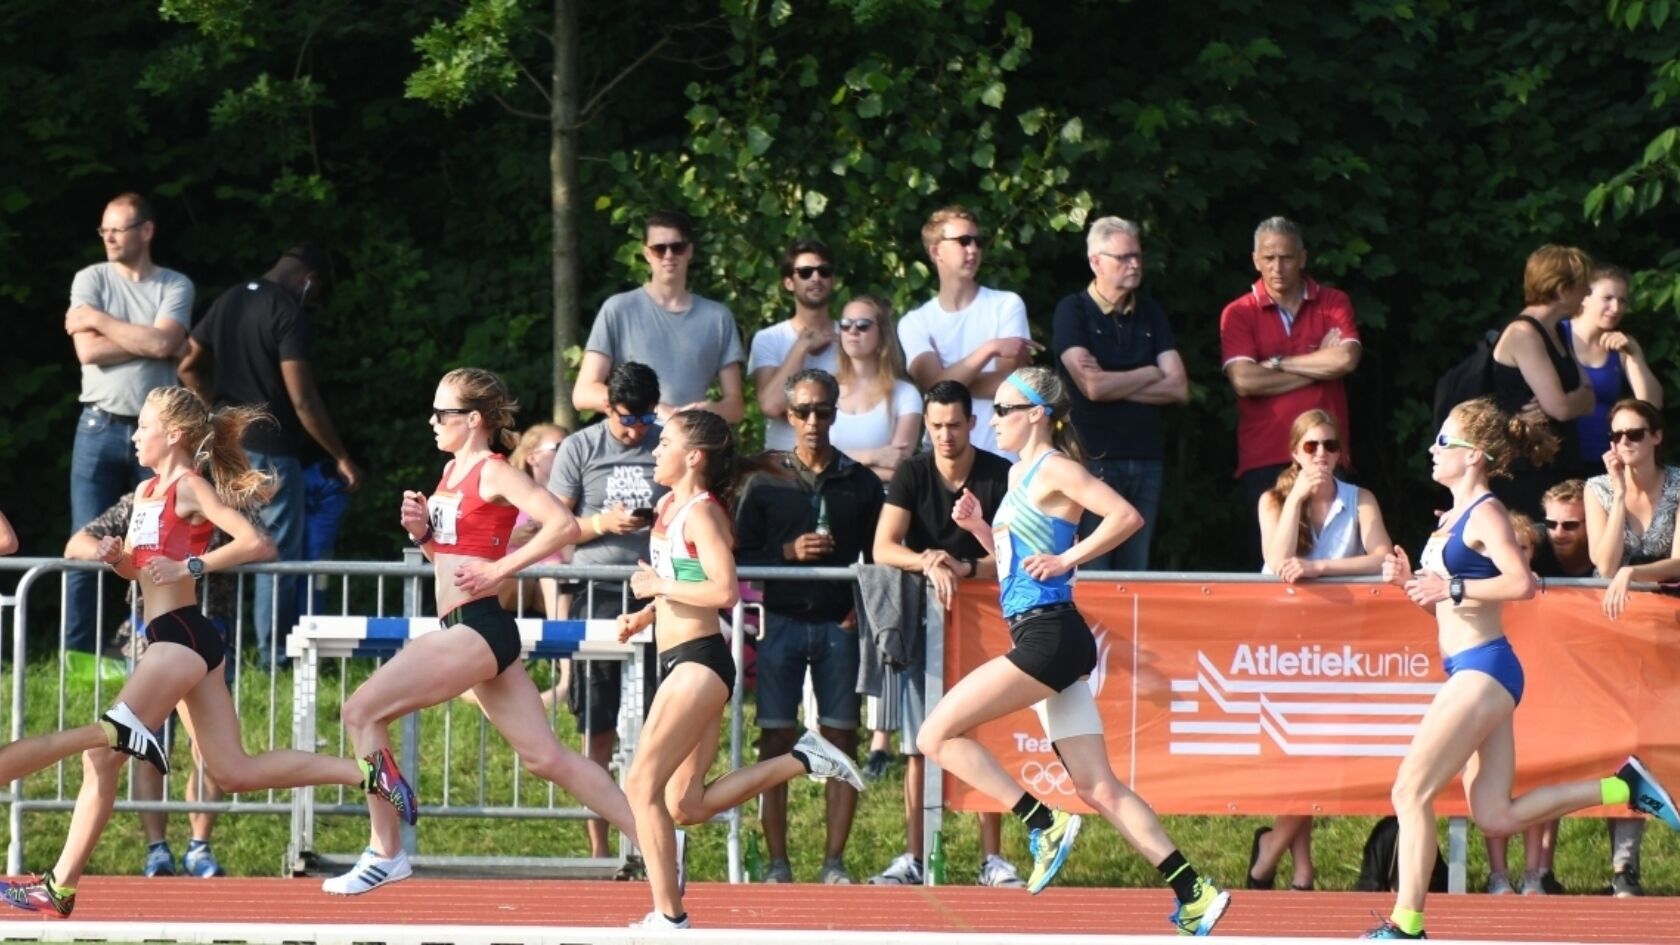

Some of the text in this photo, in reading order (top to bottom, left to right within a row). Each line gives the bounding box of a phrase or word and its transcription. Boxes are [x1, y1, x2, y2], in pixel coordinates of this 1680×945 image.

[613, 466, 643, 478] NYC
[607, 477, 650, 489] ROMA
[606, 488, 652, 500] TOKYO
[1230, 643, 1430, 678] Atletiekunie
[1012, 732, 1052, 753] Tea
